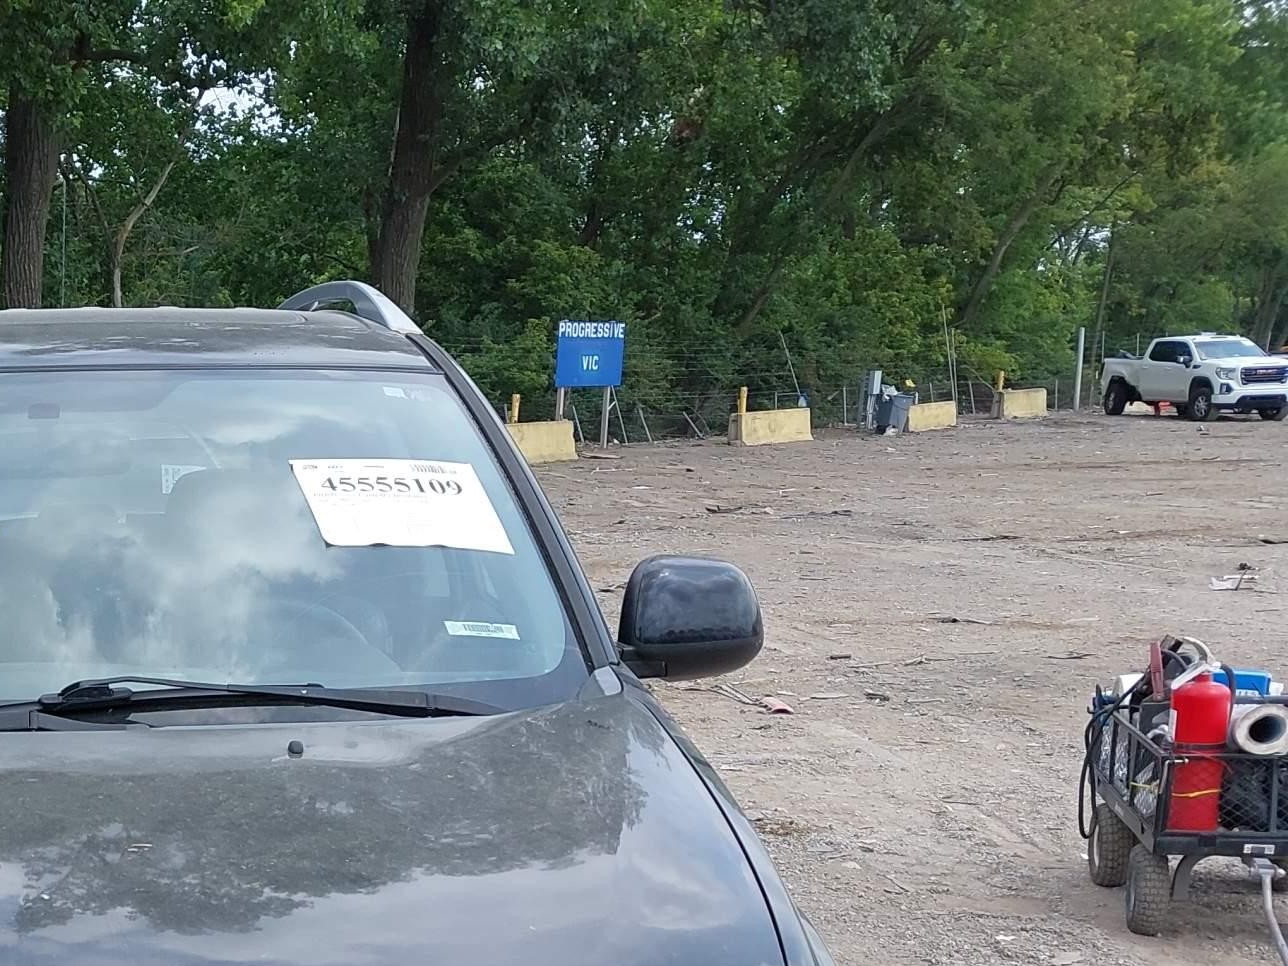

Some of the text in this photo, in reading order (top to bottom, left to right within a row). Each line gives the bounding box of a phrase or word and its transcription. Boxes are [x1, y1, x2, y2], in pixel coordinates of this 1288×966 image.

[558, 321, 626, 339] PROGRESSIVE
[582, 354, 600, 371] VIC
[320, 476, 463, 496] 45555109
